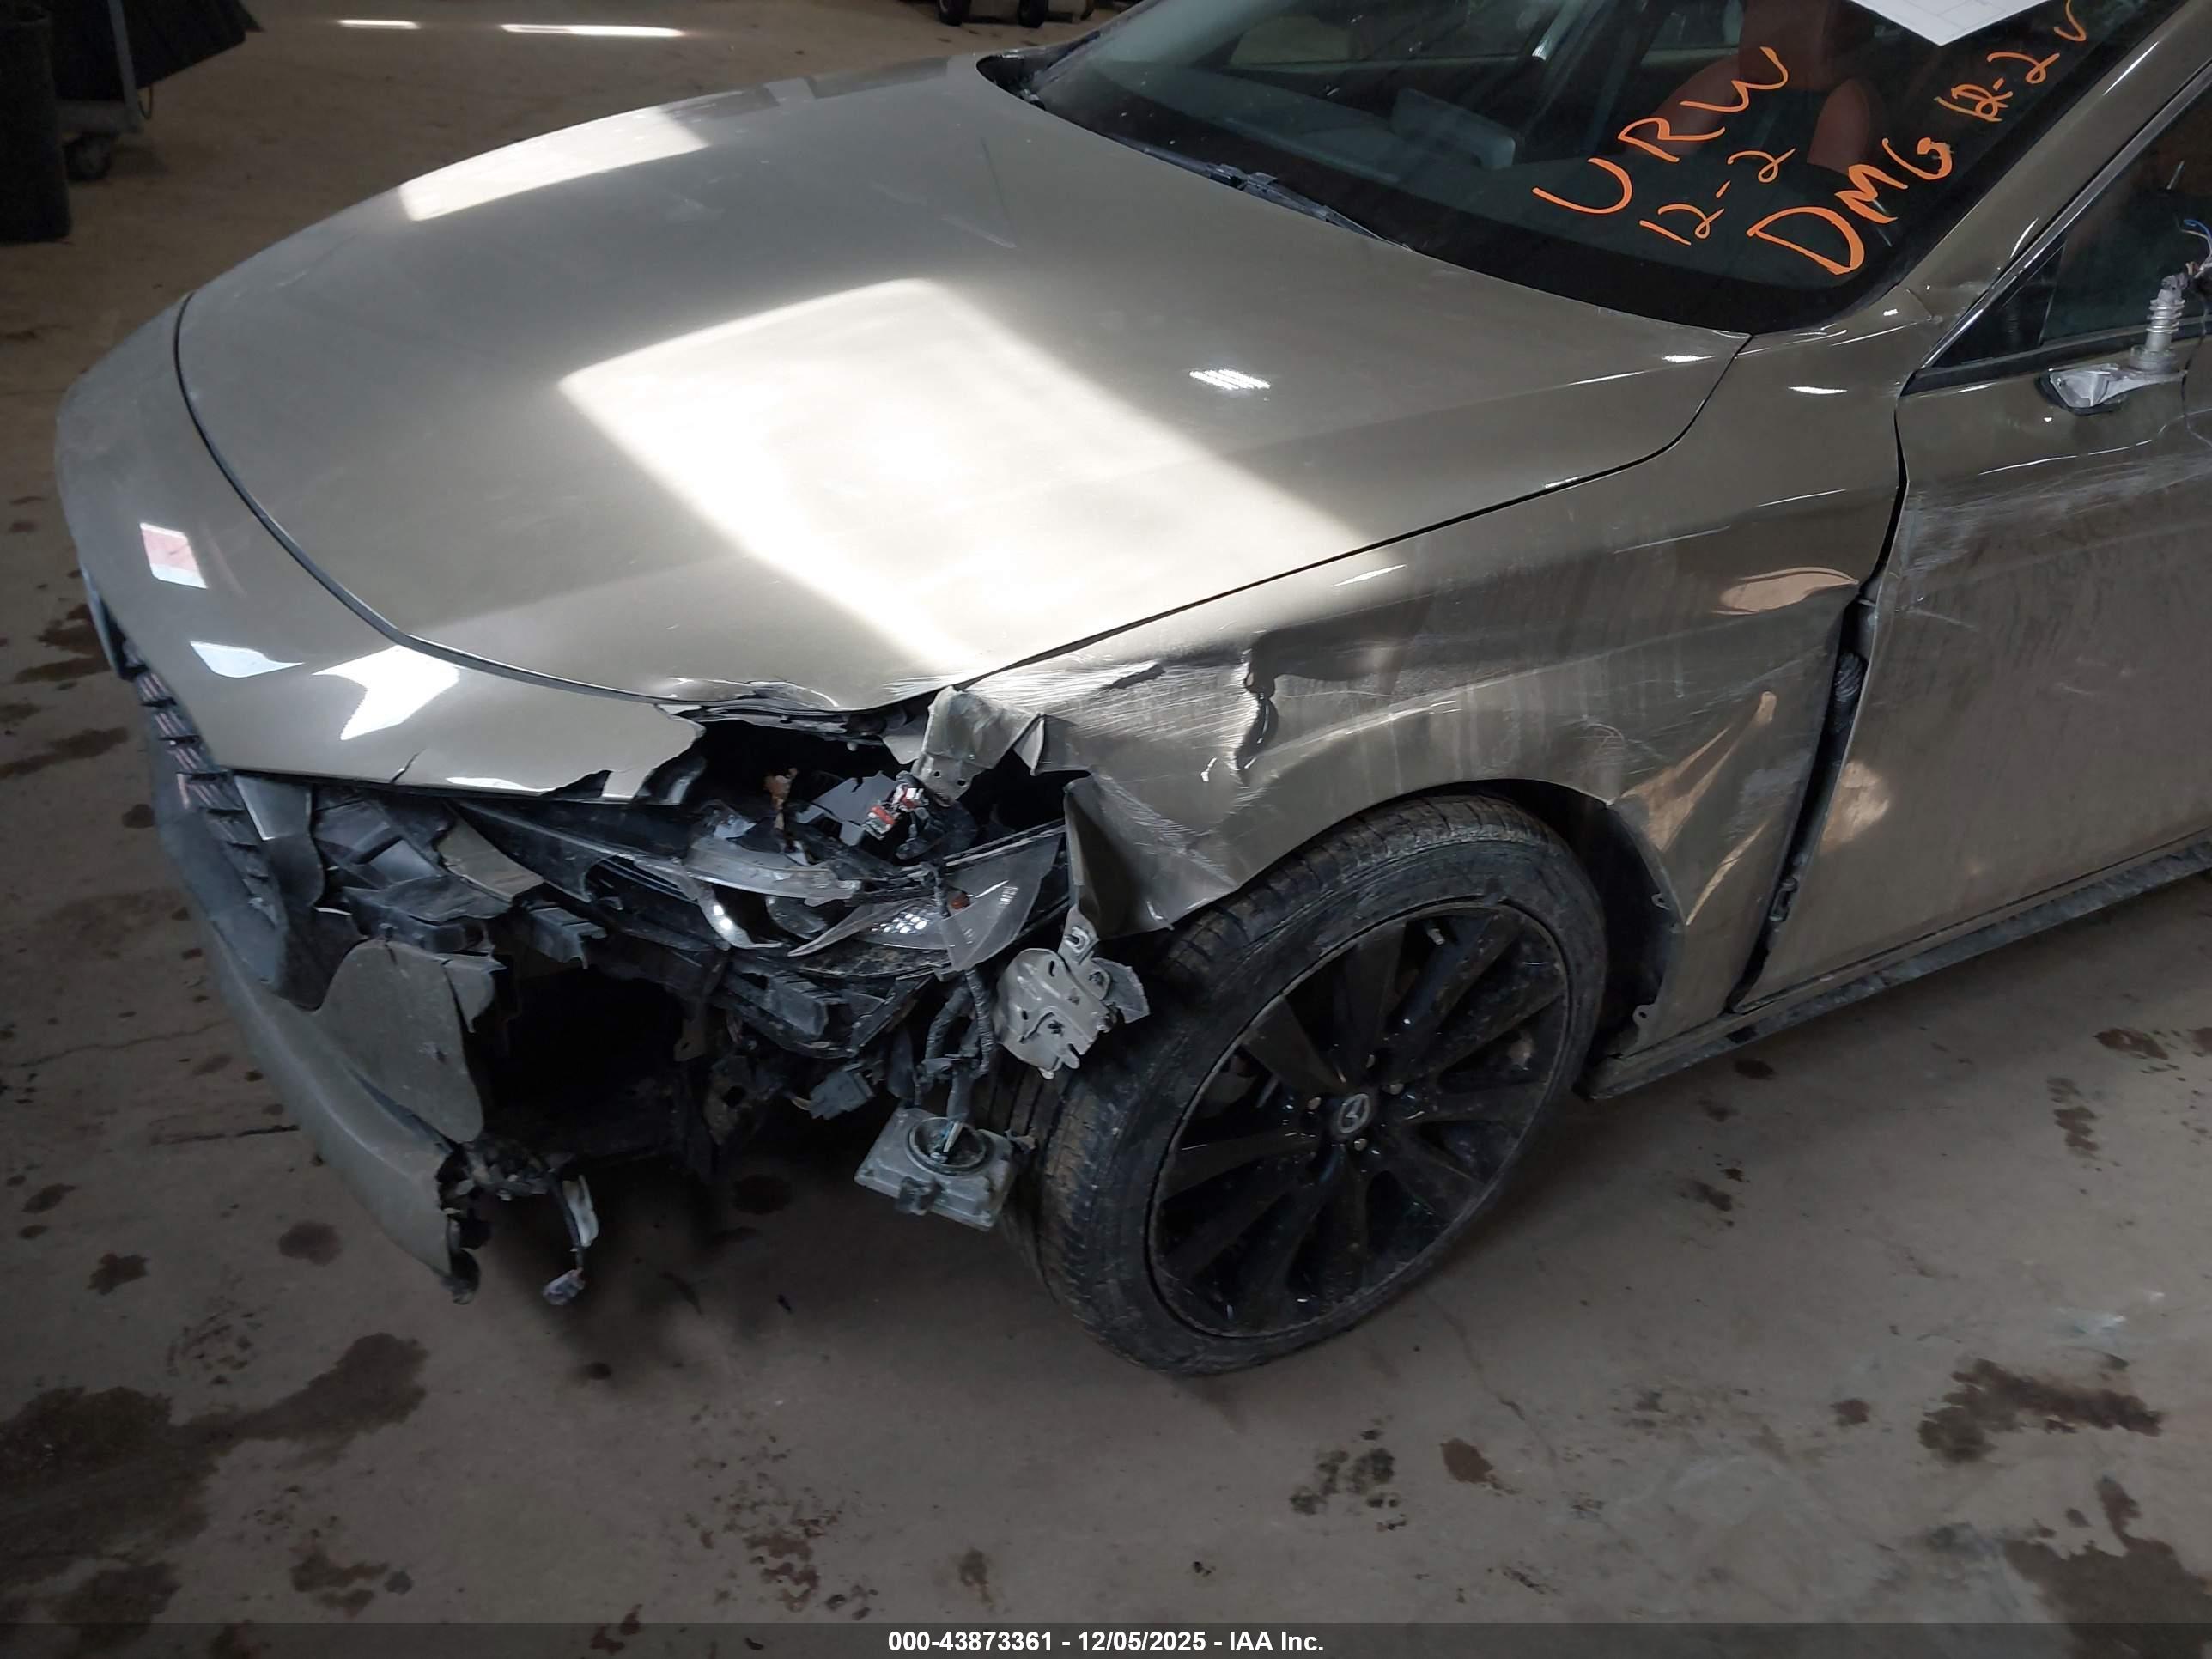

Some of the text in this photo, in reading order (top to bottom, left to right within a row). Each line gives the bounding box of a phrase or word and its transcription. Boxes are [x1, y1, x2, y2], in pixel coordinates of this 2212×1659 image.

[1532, 46, 1789, 214] URW
[1639, 148, 1796, 246] 12-2
[1747, 137, 1954, 276] DMG
